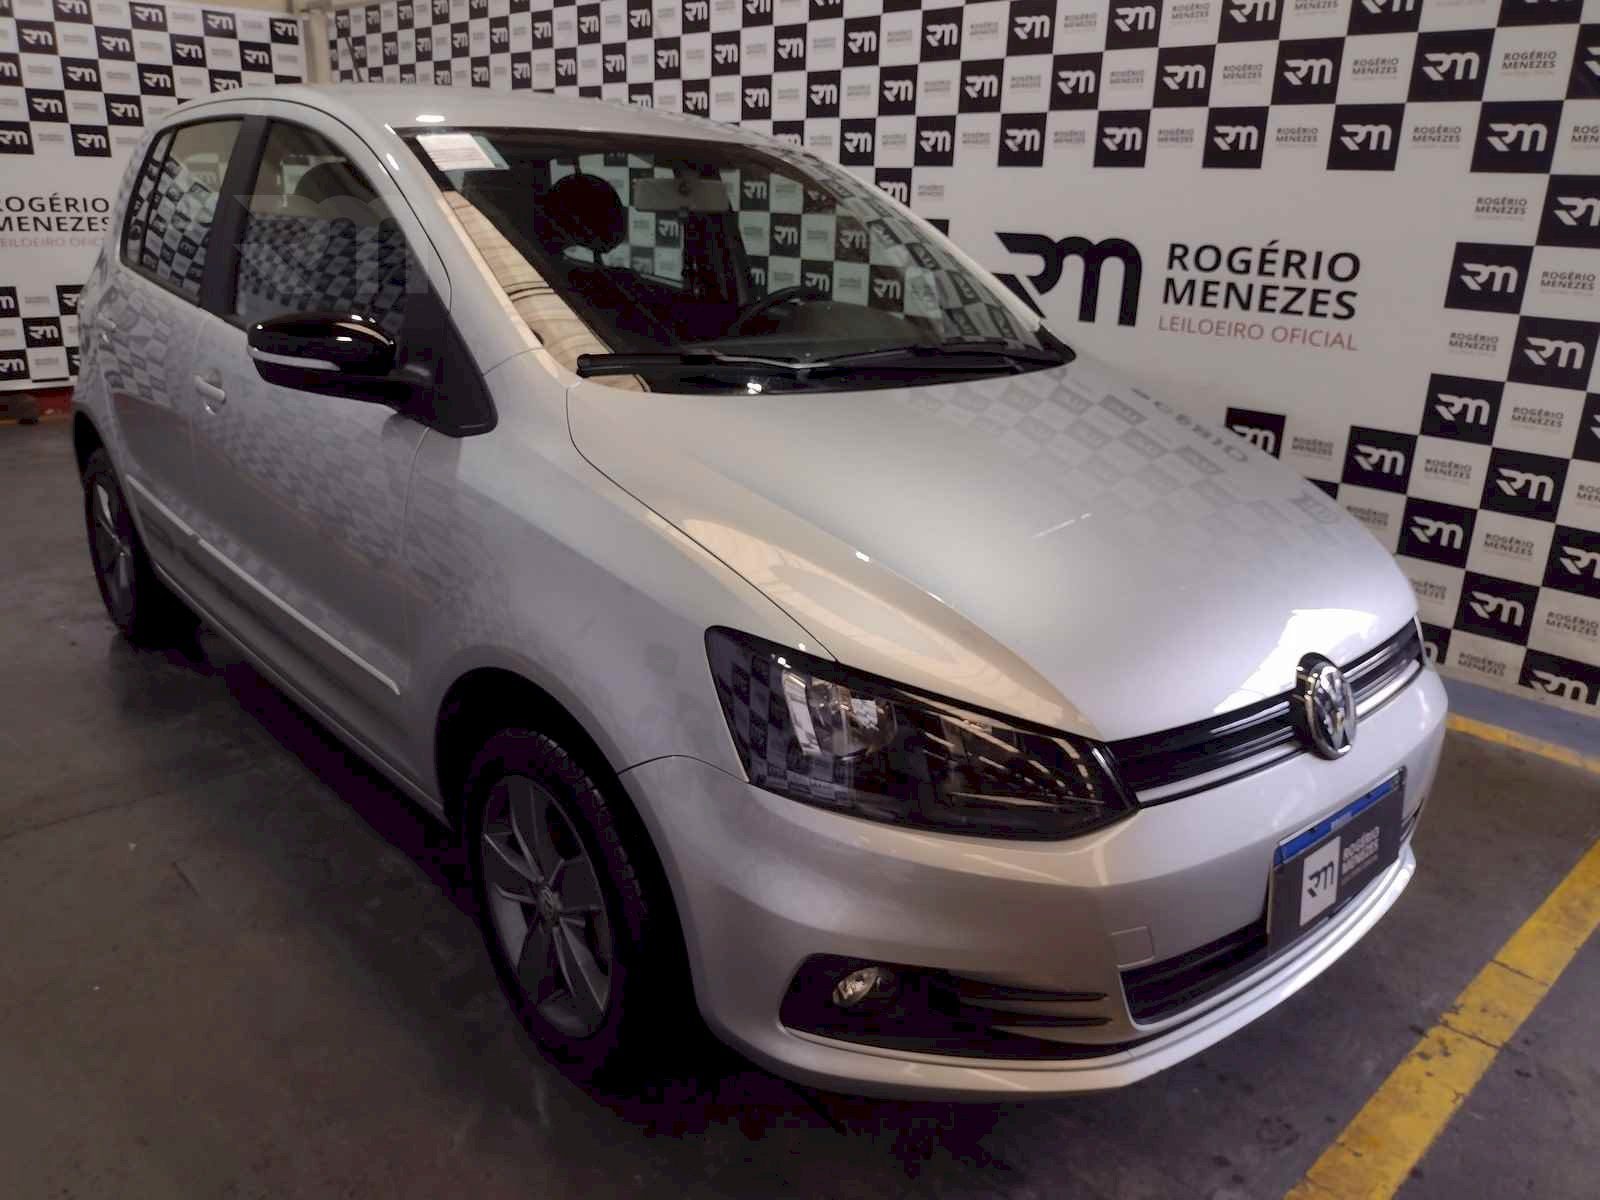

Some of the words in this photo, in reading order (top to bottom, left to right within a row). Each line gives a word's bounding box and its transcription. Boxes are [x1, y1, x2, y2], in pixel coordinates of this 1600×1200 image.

[1504, 49, 1557, 61] ROGÉRIO
[1353, 56, 1399, 68] ROGÉRIO
[1503, 60, 1556, 70] MENEZES
[1352, 65, 1398, 75] MENEZES
[1414, 124, 1461, 134] ROGÉRIO
[1412, 133, 1460, 143] MENEZES
[0, 192, 110, 213] OGÉRIO
[1477, 196, 1527, 207] ROGÉRIO
[1475, 205, 1526, 215] MENEZES
[1167, 239, 1361, 283] ROGÉRIO
[1542, 270, 1596, 282] ROGÉRIO
[1540, 280, 1594, 291] MENEZES
[1162, 277, 1359, 320] MENEZES
[1158, 314, 1264, 342] LEILOEIRO
[1271, 325, 1358, 351] OFICIAL
[1450, 332, 1499, 344] ROGÉRIO
[1449, 340, 1497, 352] MENEZES
[1513, 406, 1564, 420] ROGÉRIO
[1512, 414, 1563, 428] MENEZES
